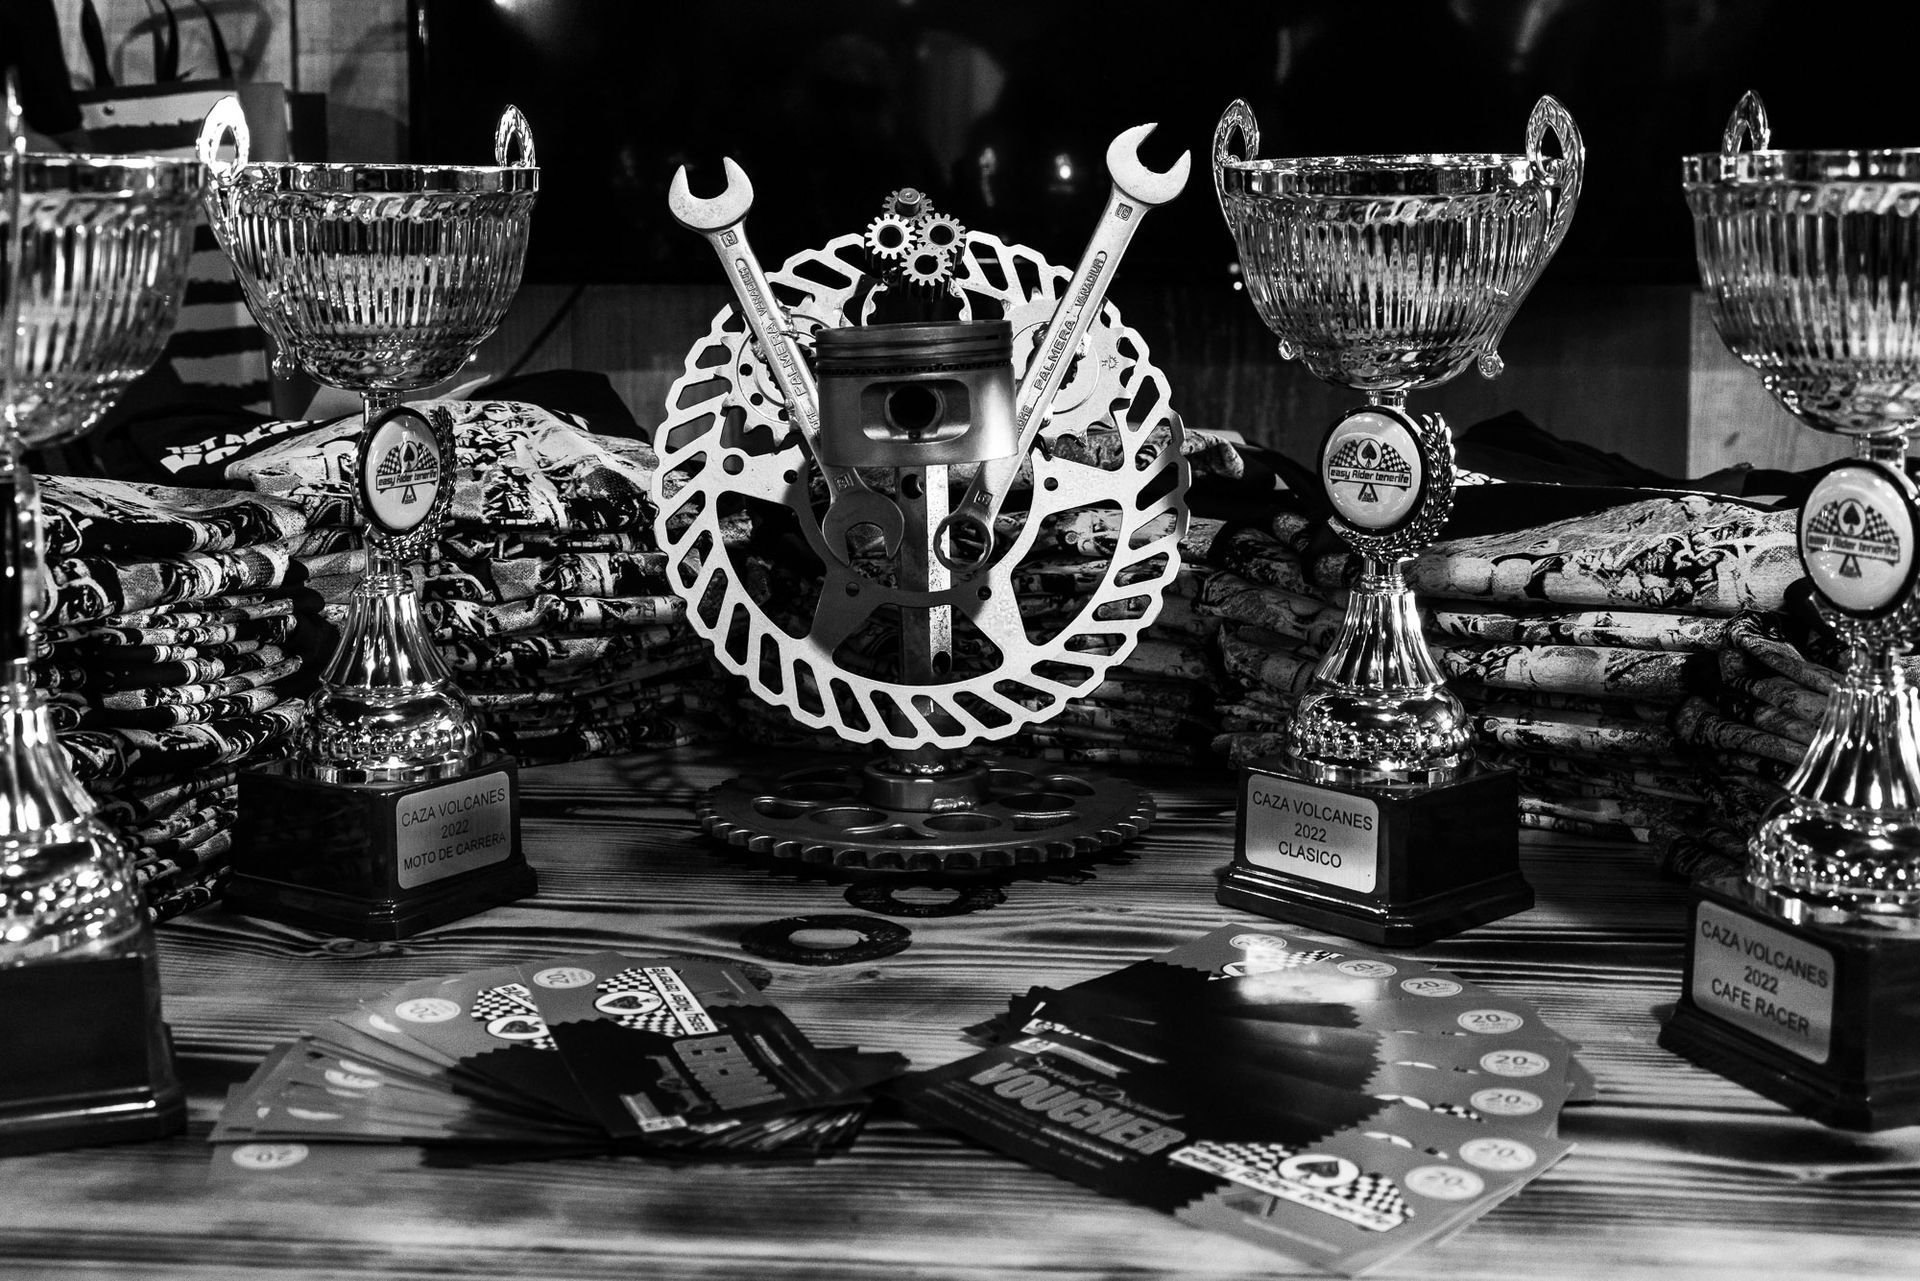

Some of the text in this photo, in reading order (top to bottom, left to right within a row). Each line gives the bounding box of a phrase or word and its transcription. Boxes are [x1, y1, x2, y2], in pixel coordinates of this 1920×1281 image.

[739, 266, 768, 317] VANADIUM
[1034, 320, 1076, 391] PALMERA
[1075, 258, 1104, 308] VANADIUM
[765, 322, 807, 397] PALMERA
[1330, 469, 1410, 484] easy Rider tenerife
[401, 788, 506, 827] CAZA VOLCANES
[1252, 791, 1373, 831] CAZA VOLCANES
[441, 820, 469, 839] 2022
[1294, 822, 1327, 843] 2022
[403, 832, 506, 871] MOTO DE CARRERA
[1278, 841, 1342, 868] CLASICO
[1701, 920, 1828, 989] CAZA VOLCANES
[1744, 966, 1779, 996] 2022
[1711, 978, 1810, 1036] CAFE RACER
[969, 1061, 1187, 1155] VOUCHER
